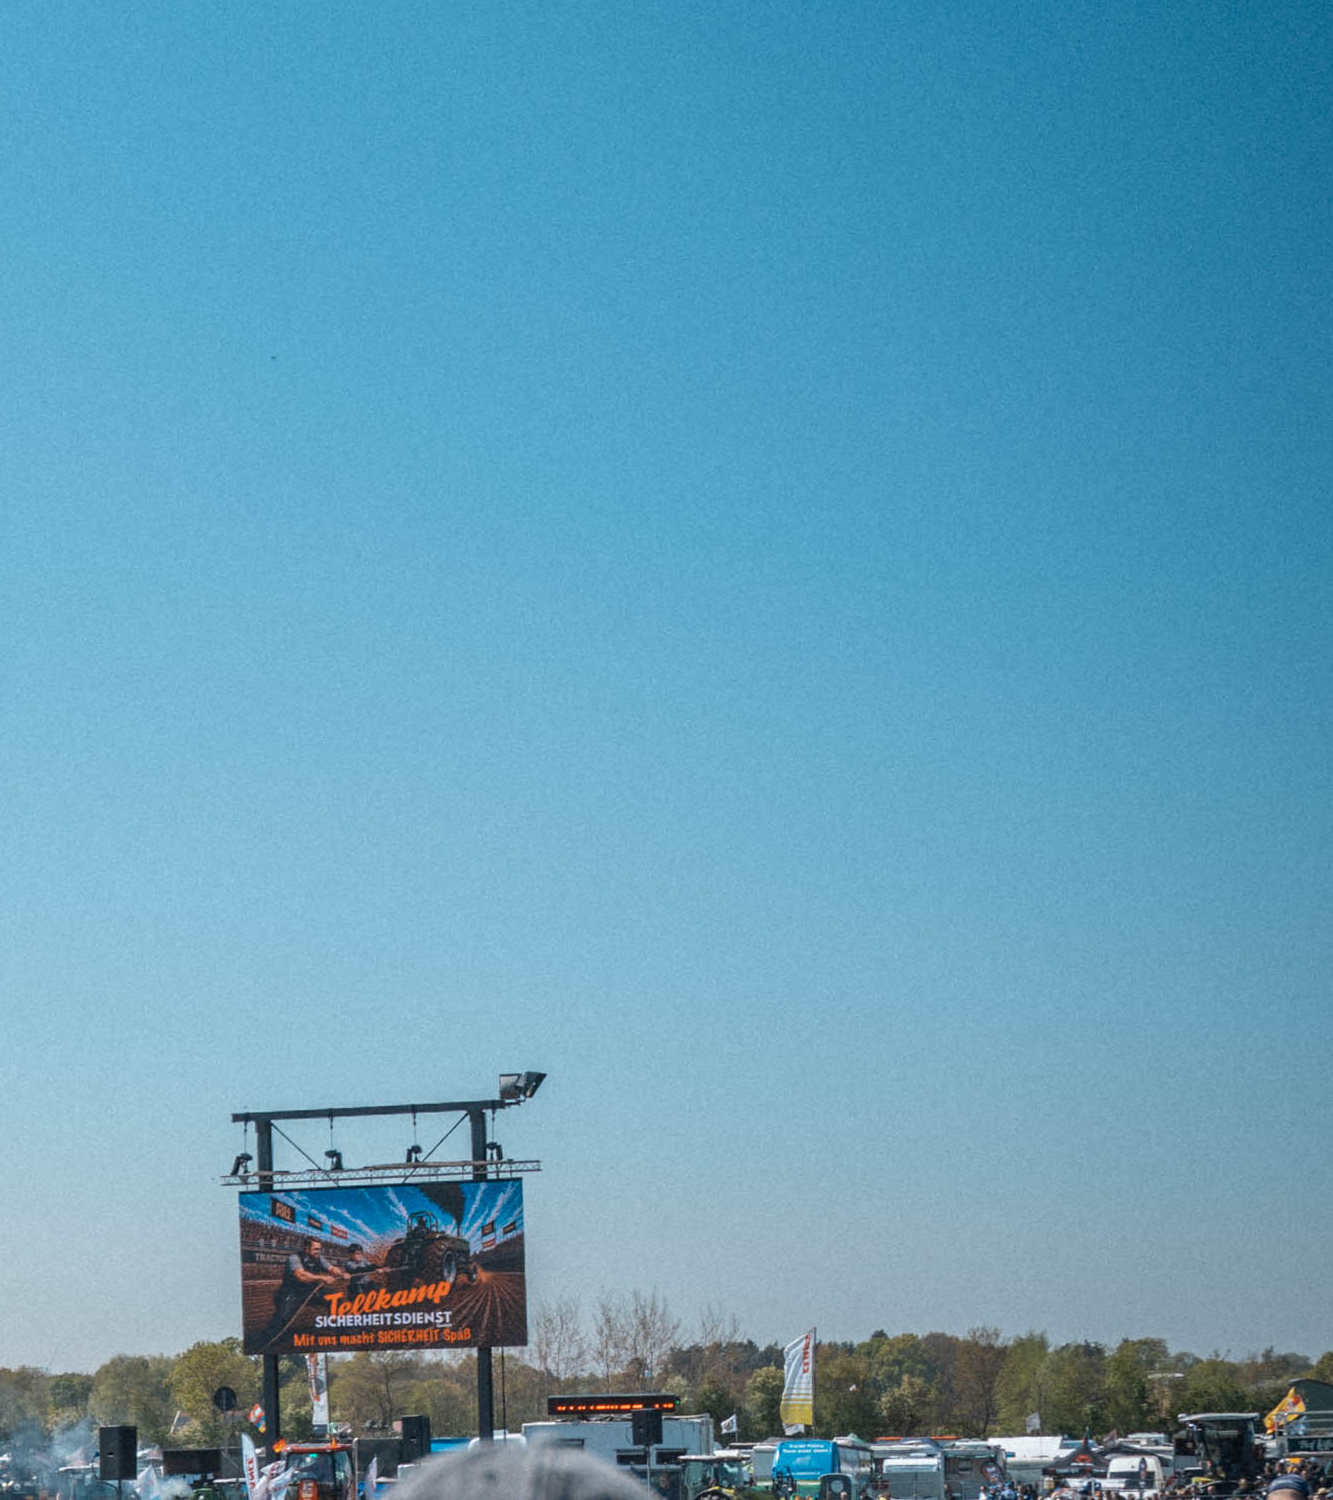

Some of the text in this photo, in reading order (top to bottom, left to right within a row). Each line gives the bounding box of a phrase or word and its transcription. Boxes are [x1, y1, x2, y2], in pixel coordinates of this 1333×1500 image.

[324, 1280, 452, 1317] Tellkamp
[315, 1311, 452, 1328] SICHERHEITSDIENST
[294, 1333, 315, 1347] Mit
[318, 1335, 337, 1346] uns
[340, 1332, 374, 1345] macht
[378, 1328, 439, 1344] SICHERHEIT
